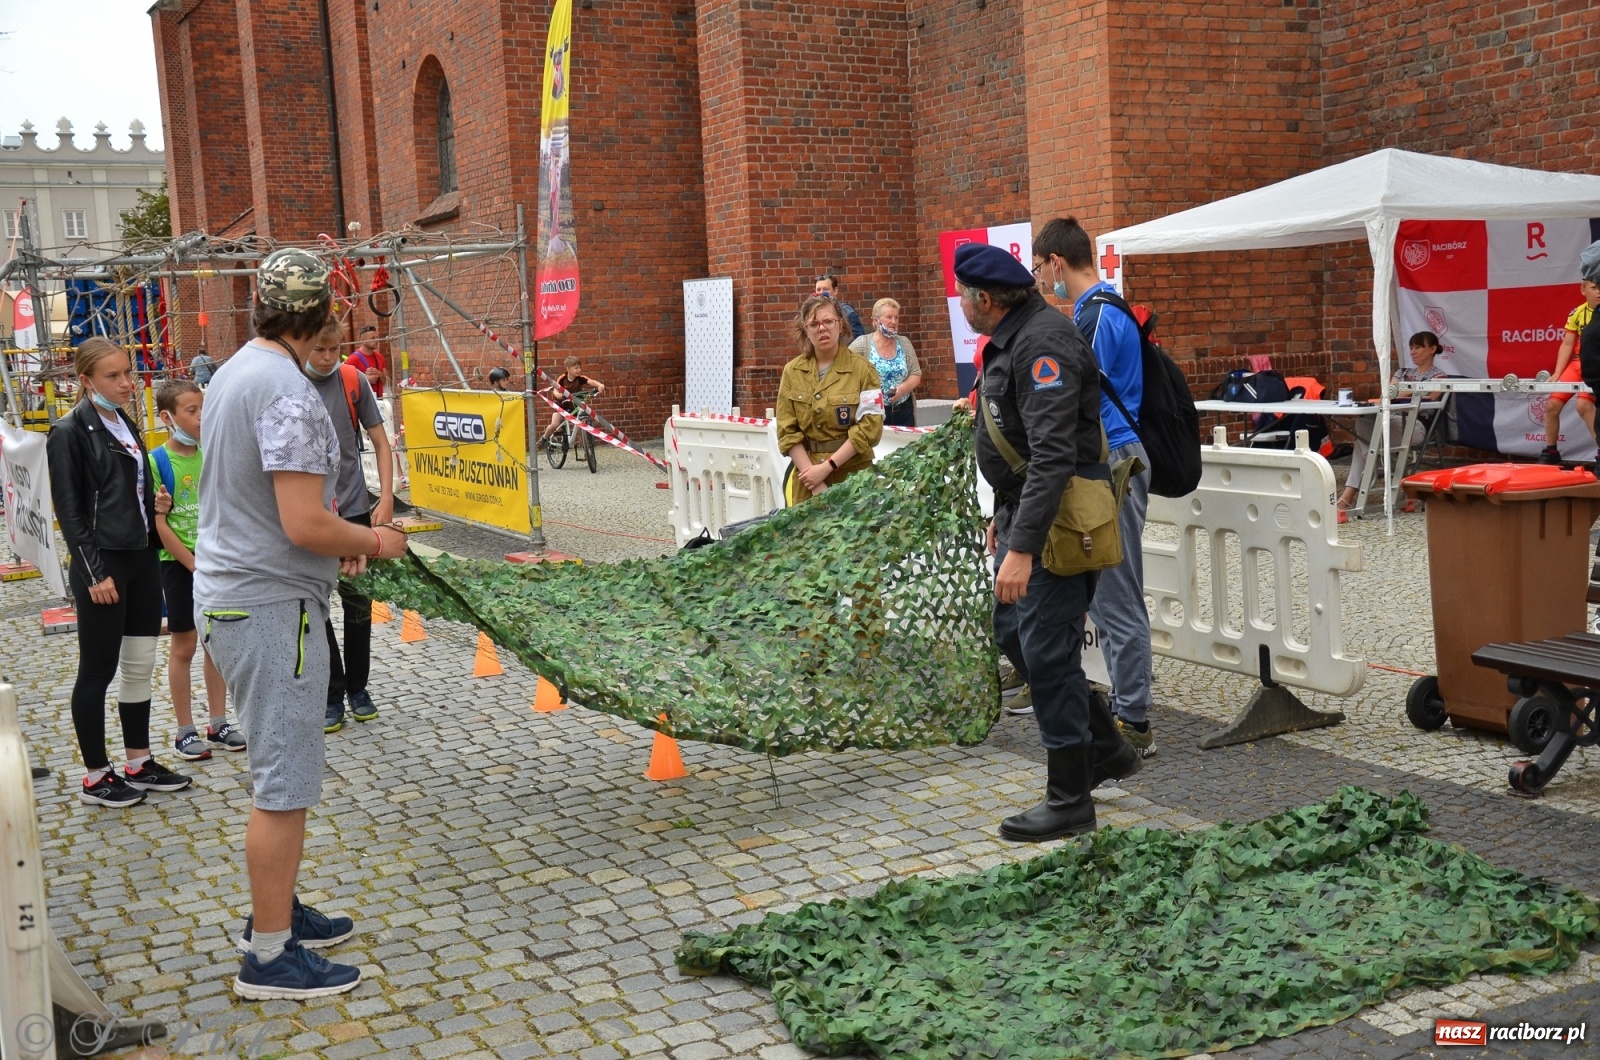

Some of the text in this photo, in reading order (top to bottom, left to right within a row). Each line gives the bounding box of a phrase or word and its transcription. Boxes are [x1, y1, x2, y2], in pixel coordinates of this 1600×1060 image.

[1432, 240, 1468, 252] RACIBÓRZ
[1527, 222, 1546, 249] R
[1009, 242, 1022, 262] R
[1502, 324, 1567, 343] RACIBÓR
[434, 415, 486, 440] ERIGO
[414, 452, 519, 491] WYNAJEM RUSZTOWAŃ
[18, 902, 35, 931] 121
